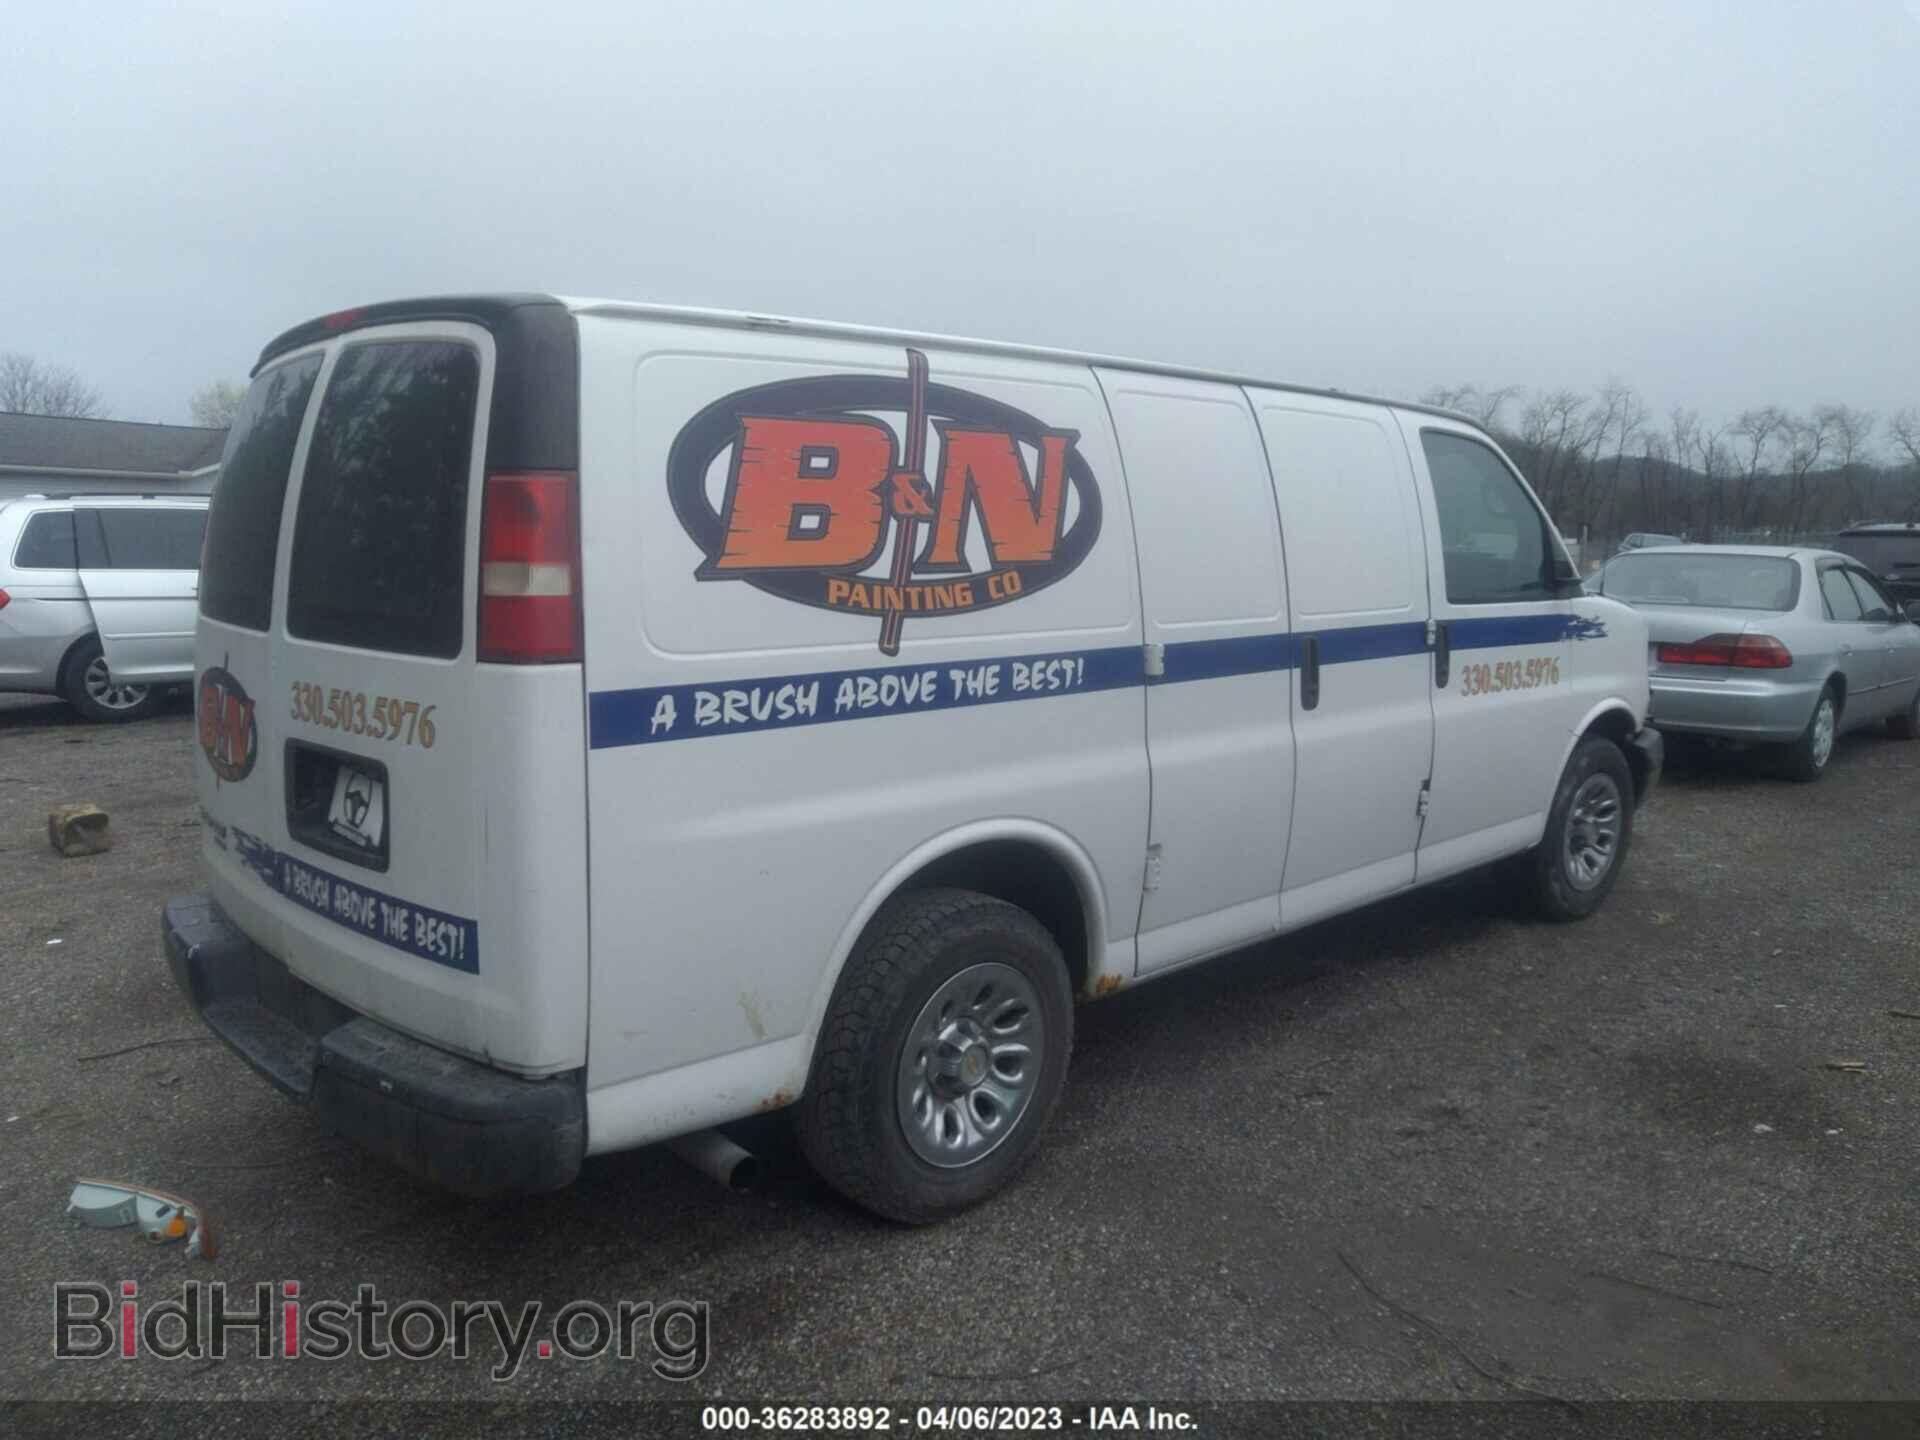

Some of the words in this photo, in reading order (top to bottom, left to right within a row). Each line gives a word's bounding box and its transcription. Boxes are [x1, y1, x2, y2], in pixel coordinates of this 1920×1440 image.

[702, 414, 1079, 580] B&N
[827, 578, 975, 611] PAINTING
[987, 569, 1023, 600] CO
[650, 694, 678, 735] A
[694, 680, 821, 727] BRUSH
[834, 670, 939, 715] ABOVE
[949, 664, 1001, 700] THE
[1012, 657, 1085, 692] BEST!
[1461, 655, 1561, 696] 330.503.5976
[290, 680, 436, 748] 330.503.5976
[333, 883, 377, 931] ABOVE
[379, 901, 409, 942] THE
[414, 911, 466, 960] BEST!
